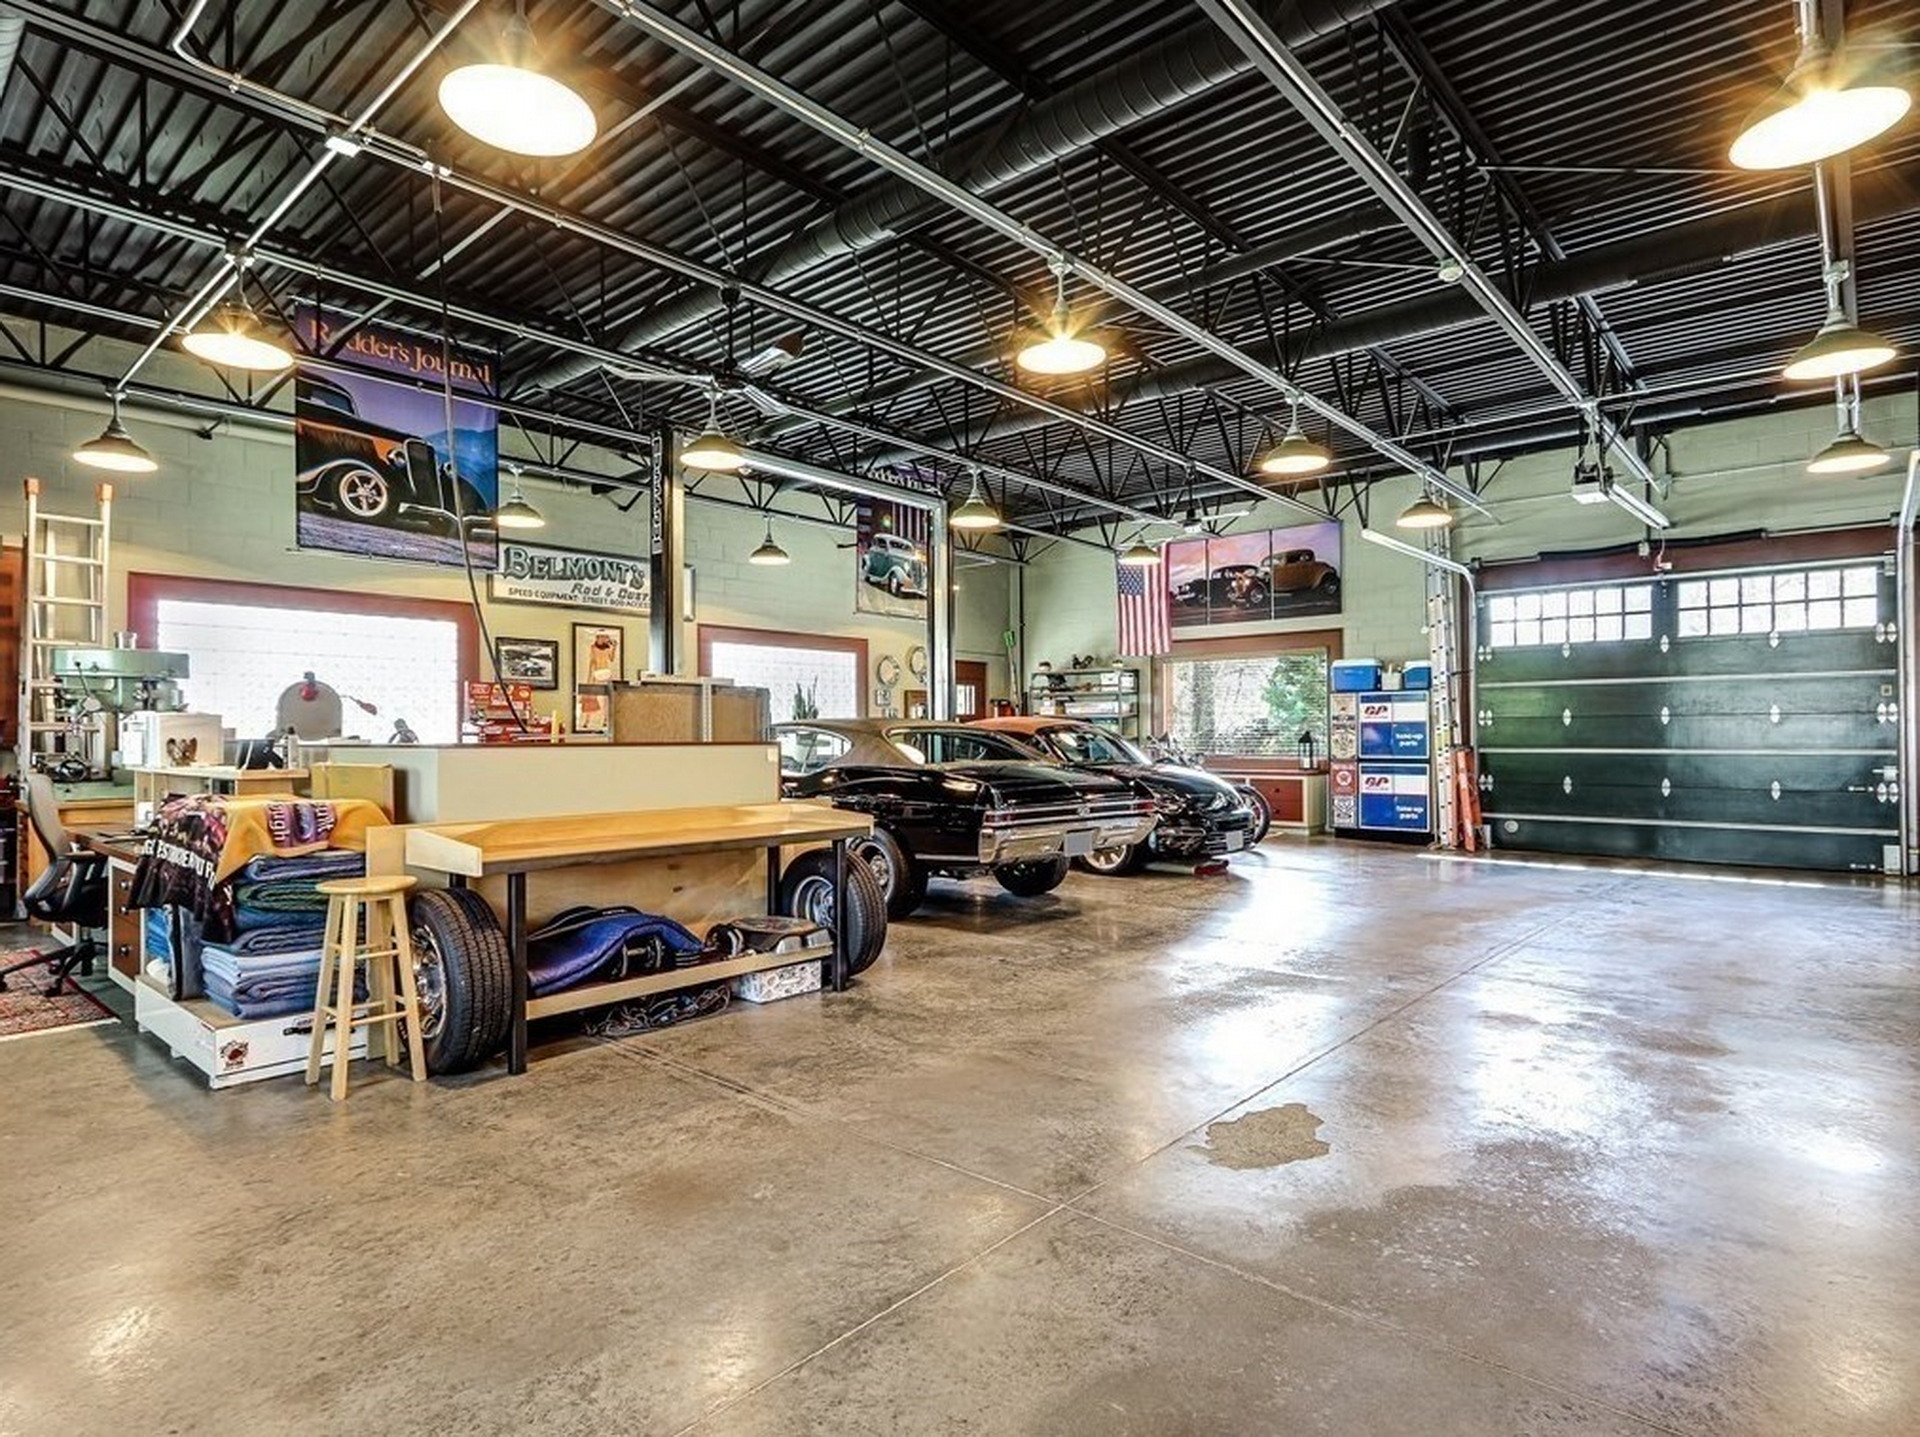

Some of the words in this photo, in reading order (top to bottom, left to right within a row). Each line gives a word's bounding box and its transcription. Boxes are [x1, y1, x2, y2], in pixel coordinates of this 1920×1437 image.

[310, 319, 409, 363] Rdder's
[508, 587, 532, 598] SPEED
[571, 582, 600, 597] Rod
[605, 587, 614, 598] &
[617, 589, 651, 602] Cust
